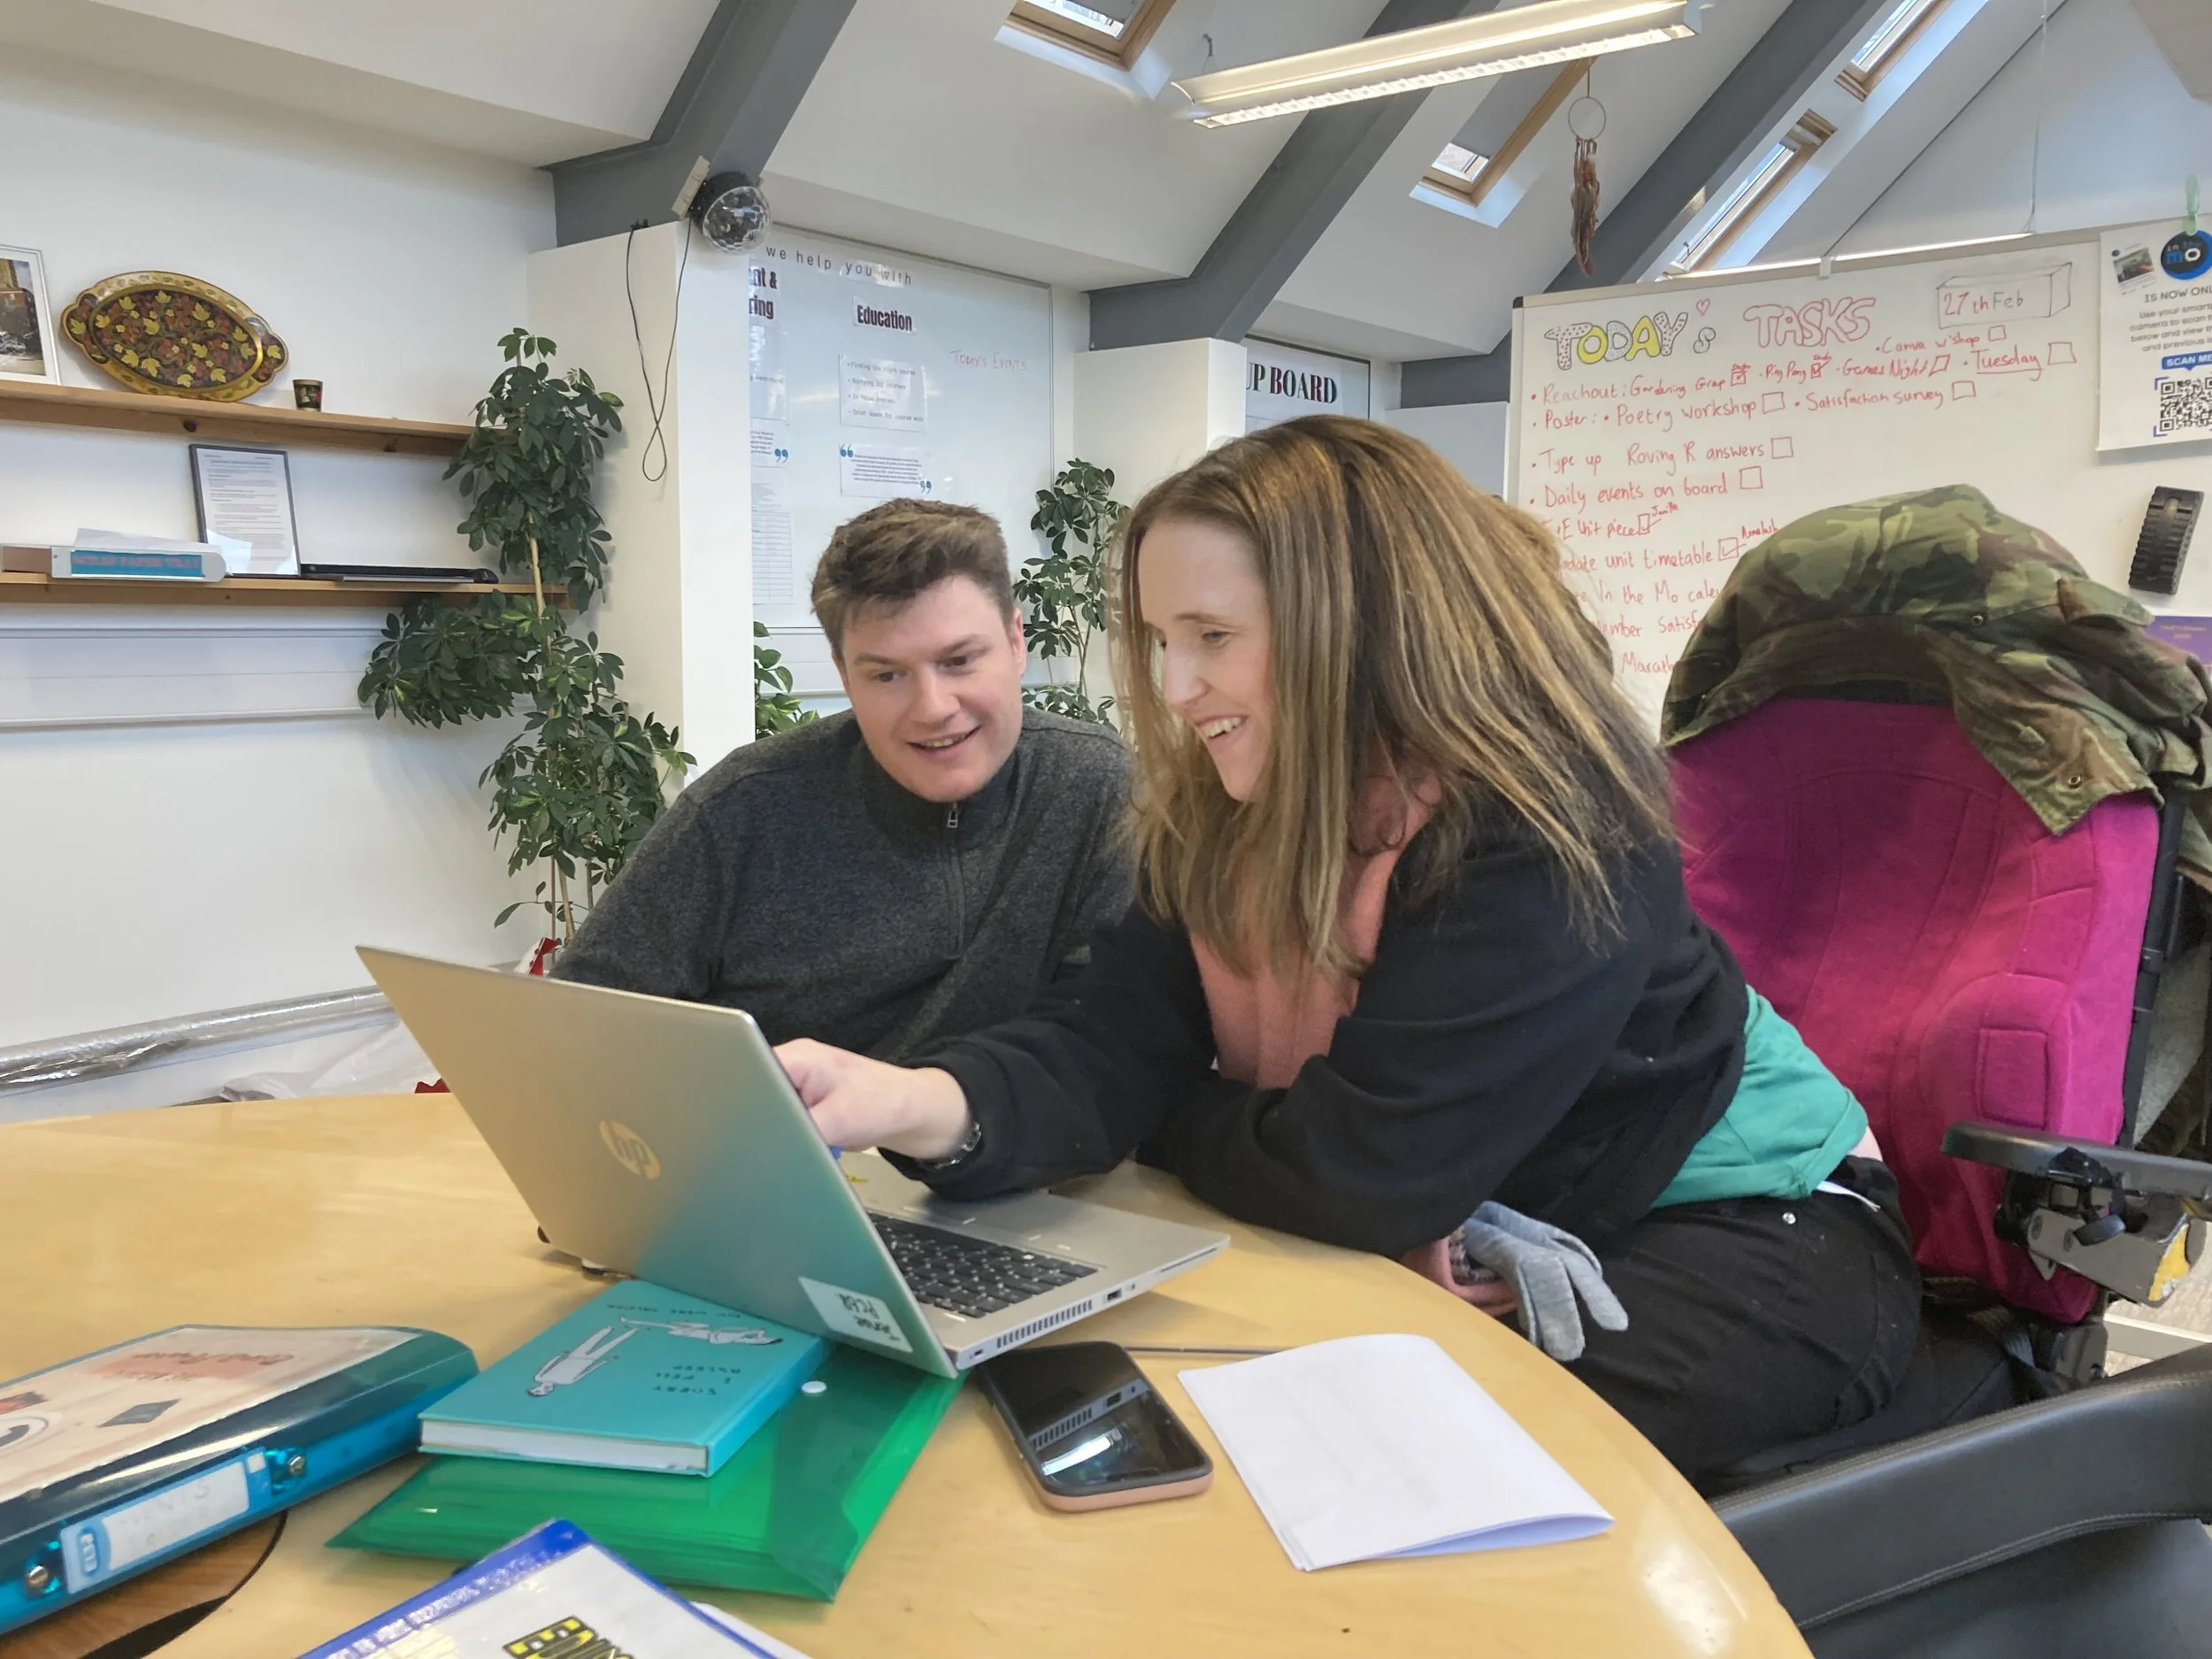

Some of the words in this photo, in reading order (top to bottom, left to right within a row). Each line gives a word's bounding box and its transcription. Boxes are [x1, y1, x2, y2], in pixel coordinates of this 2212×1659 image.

[765, 244, 787, 260] we
[796, 250, 832, 272] help
[845, 262, 872, 277] you
[880, 269, 912, 286] with
[770, 271, 778, 290] &
[1993, 288, 2024, 311] Feb
[2145, 293, 2157, 303] IS
[2161, 288, 2188, 300] NOW
[856, 304, 913, 332] Education
[1742, 296, 1877, 348] TASKS
[2159, 308, 2180, 317] your
[2130, 320, 2168, 331] camera
[2131, 334, 2159, 342] below
[2161, 329, 2180, 339] and
[1544, 311, 1689, 372] TODAY
[1882, 336, 1925, 353] Canva
[2142, 343, 2162, 352] and
[2163, 338, 2205, 350] previous
[1766, 364, 1784, 383] Ping
[1970, 344, 2042, 382] Tuesday
[2166, 356, 2195, 367] SCAN
[1269, 365, 1338, 403] BOARD
[1806, 388, 1890, 411] Satisfaction
[1894, 390, 1945, 410] survey
[1617, 403, 1675, 433] Poetry
[1681, 398, 1757, 422] workshop
[1539, 448, 1576, 475] Type
[1586, 453, 1602, 475] up
[1627, 442, 1677, 476] Roving
[1685, 441, 1696, 464] R
[1706, 443, 1765, 460] answers
[1545, 483, 1586, 515] Daily
[1597, 481, 1644, 504] events
[1654, 484, 1675, 498] on
[1683, 472, 1727, 496] board
[1607, 518, 1638, 539] piece
[1606, 550, 1635, 569] unit
[1643, 540, 1712, 569] timetable
[1623, 585, 1644, 605] the
[1655, 579, 1678, 604] Mo
[600, 1120, 661, 1180] hp
